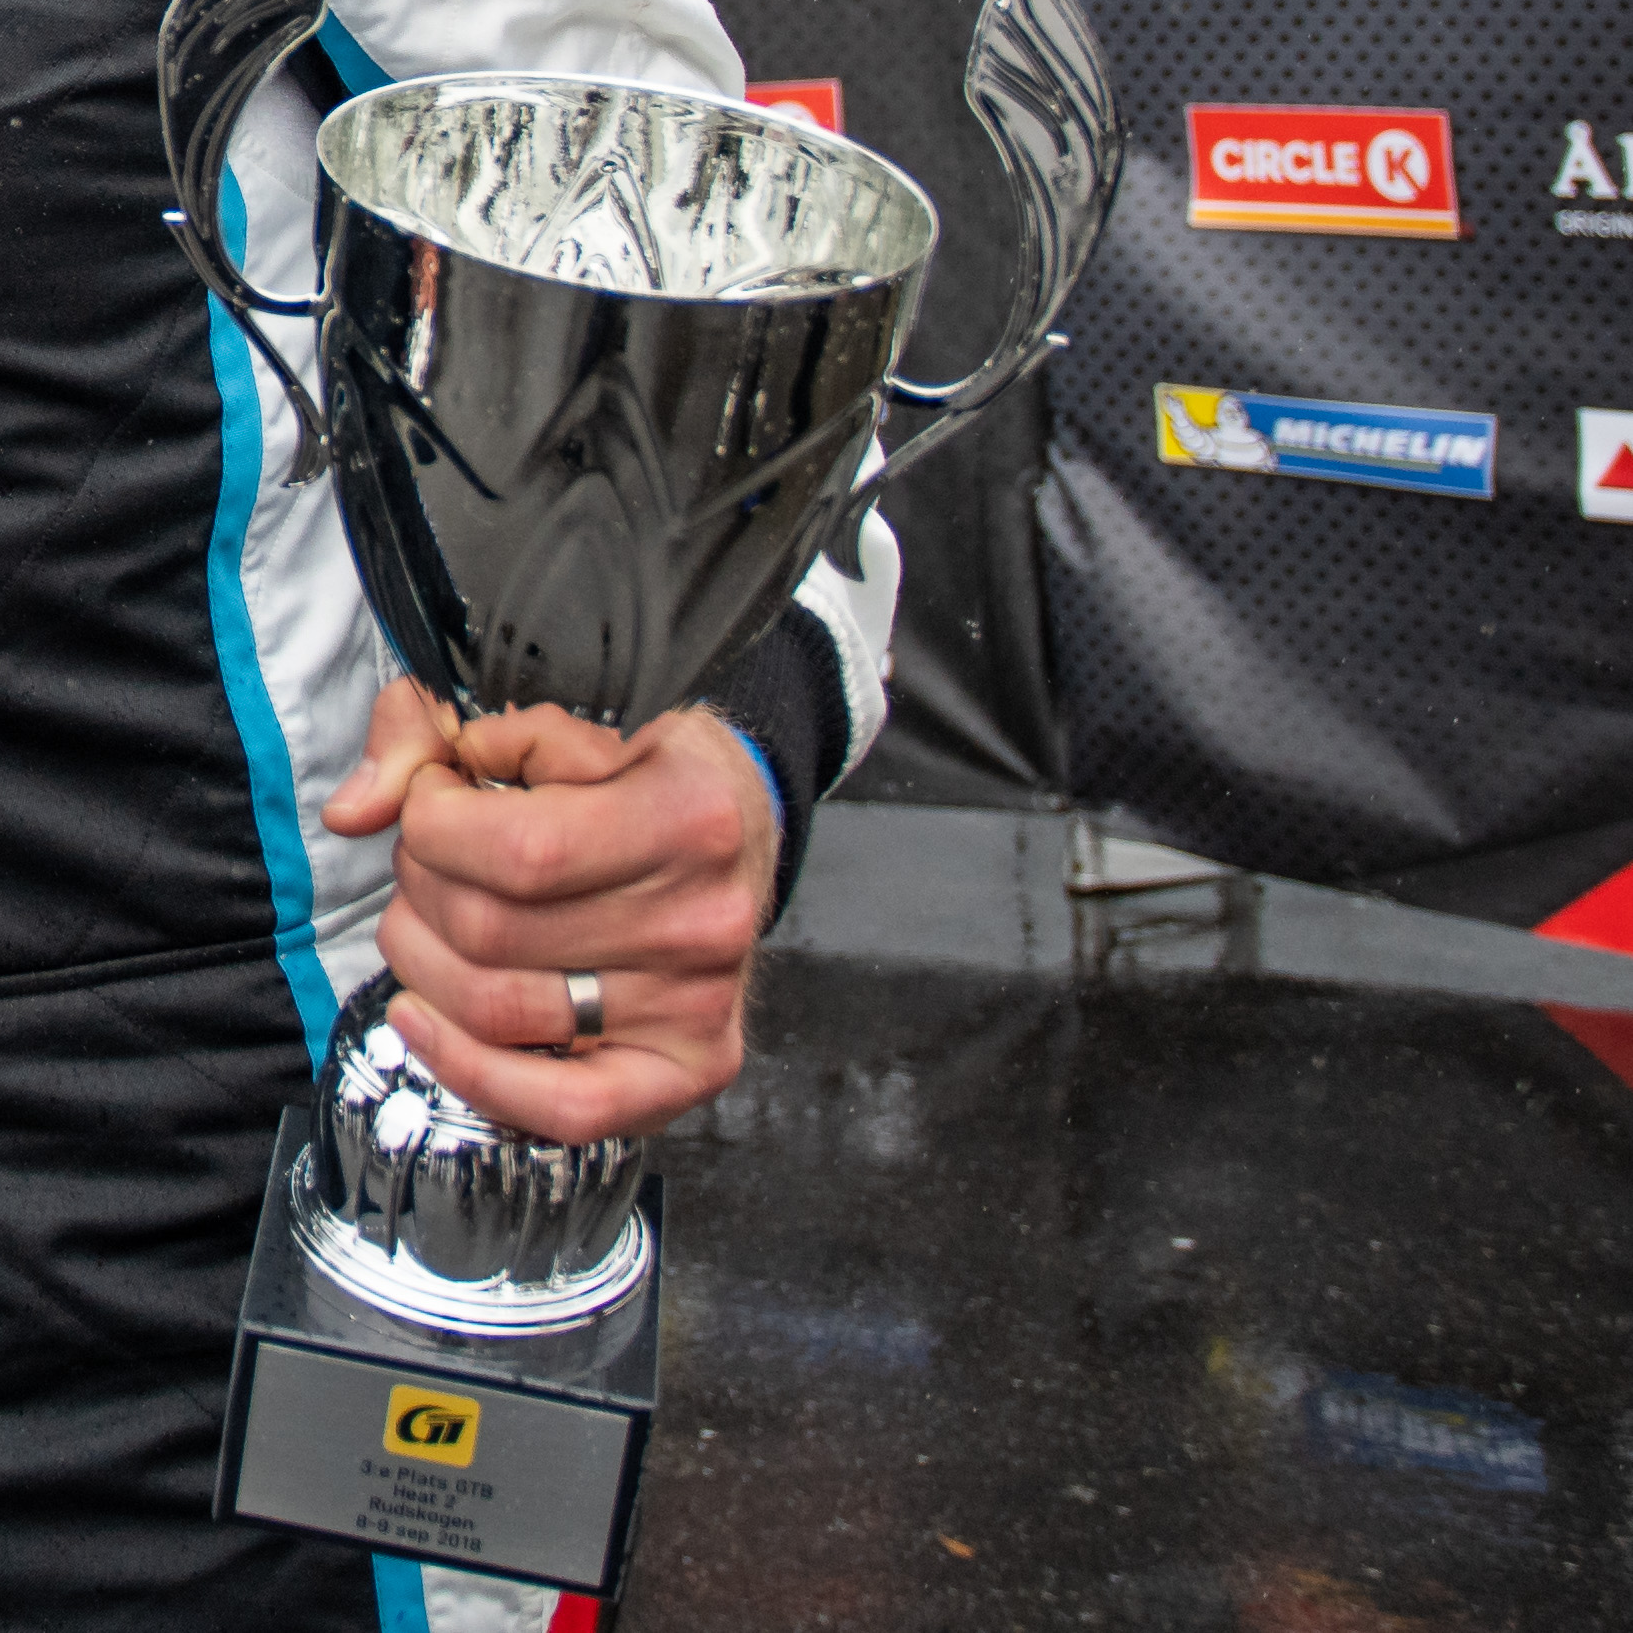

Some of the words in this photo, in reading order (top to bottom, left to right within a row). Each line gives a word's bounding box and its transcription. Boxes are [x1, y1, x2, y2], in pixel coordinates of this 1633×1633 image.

[1210, 138, 1361, 186] CIRCLE
[1365, 128, 1431, 202] K
[1272, 418, 1487, 468] MICHELIN
